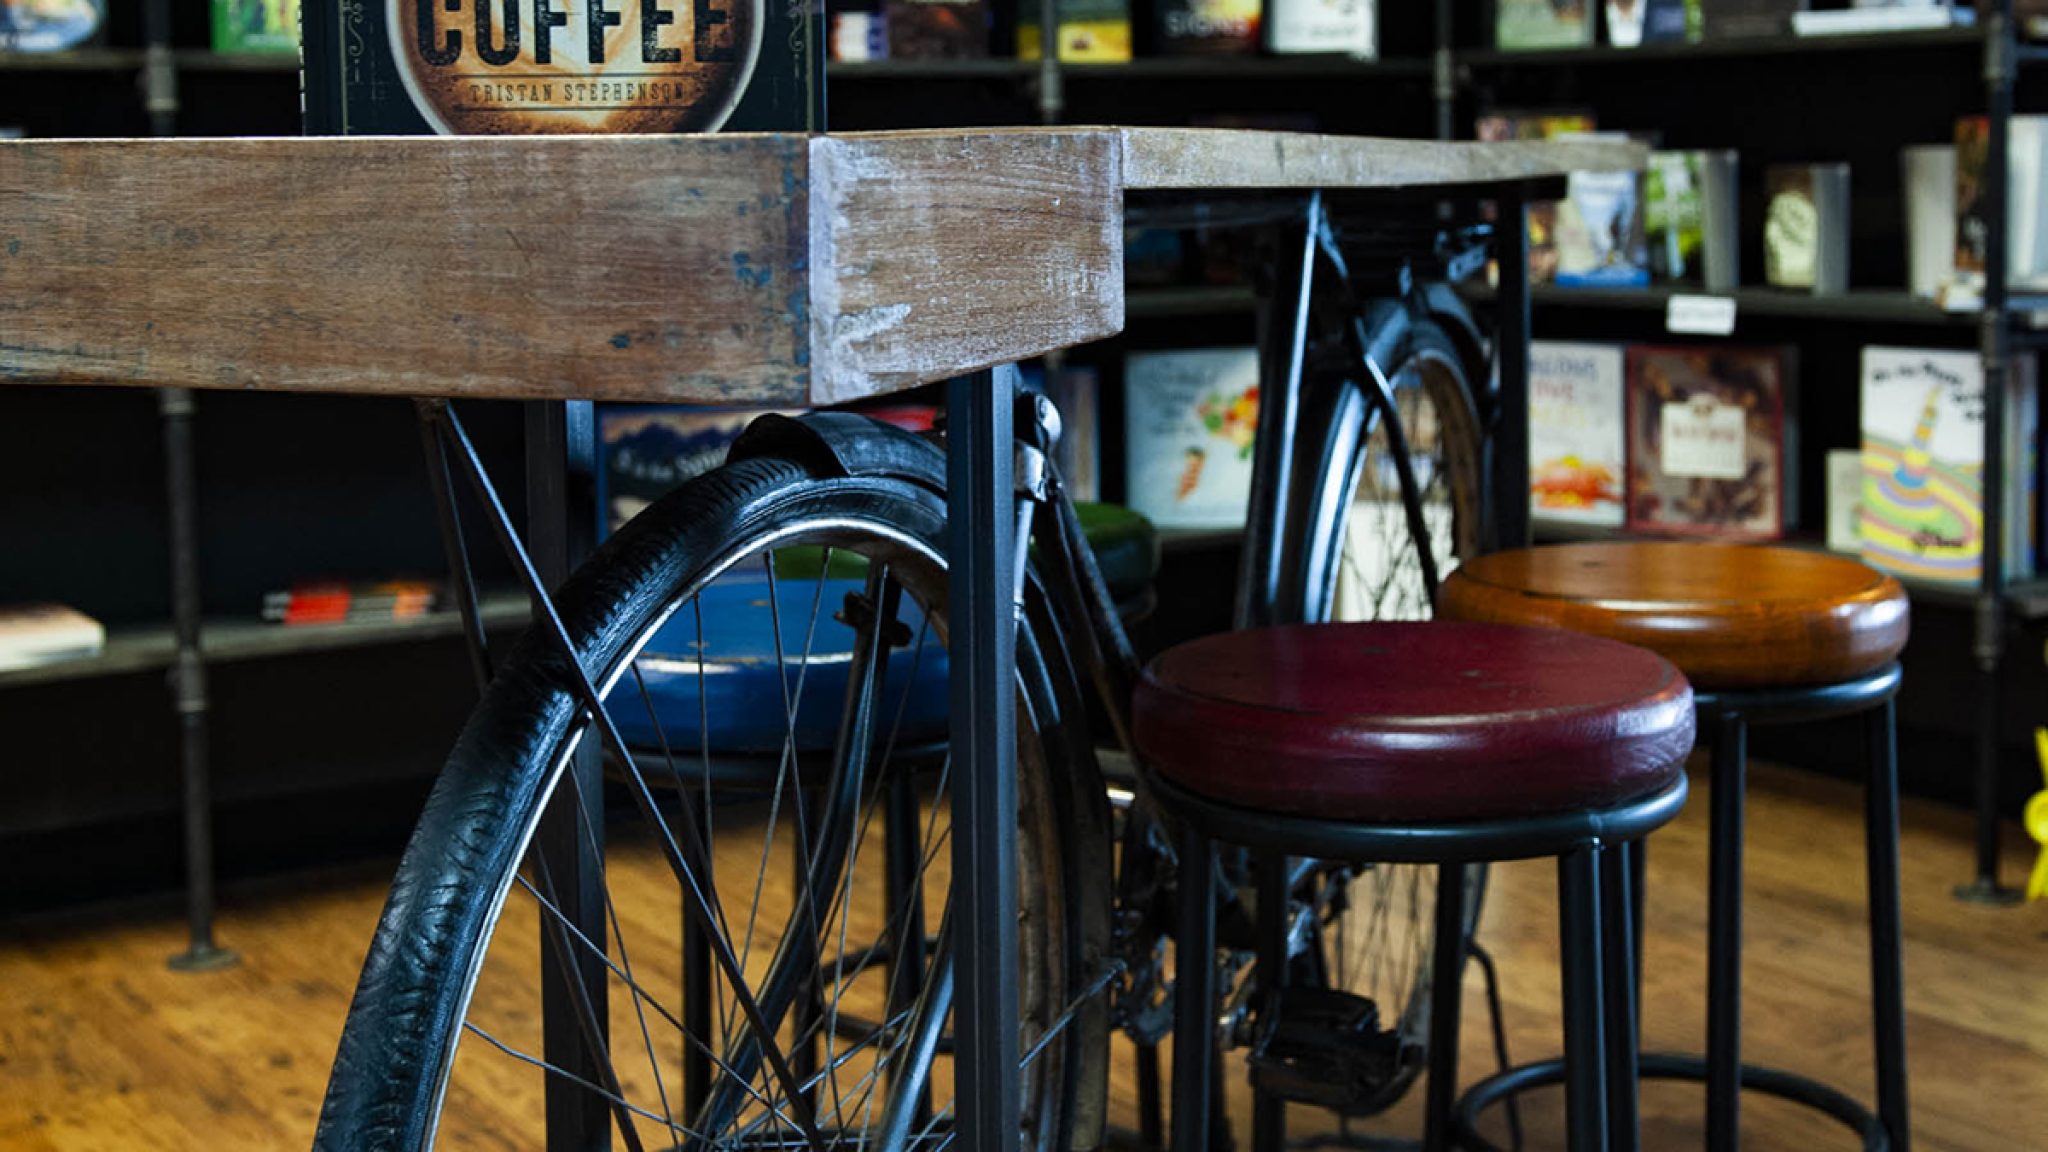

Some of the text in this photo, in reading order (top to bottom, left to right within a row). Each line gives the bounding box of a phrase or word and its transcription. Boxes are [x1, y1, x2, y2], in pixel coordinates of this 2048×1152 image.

[417, 0, 736, 66] COFFEE
[469, 83, 684, 104] TRISTAN STEPHENSON
